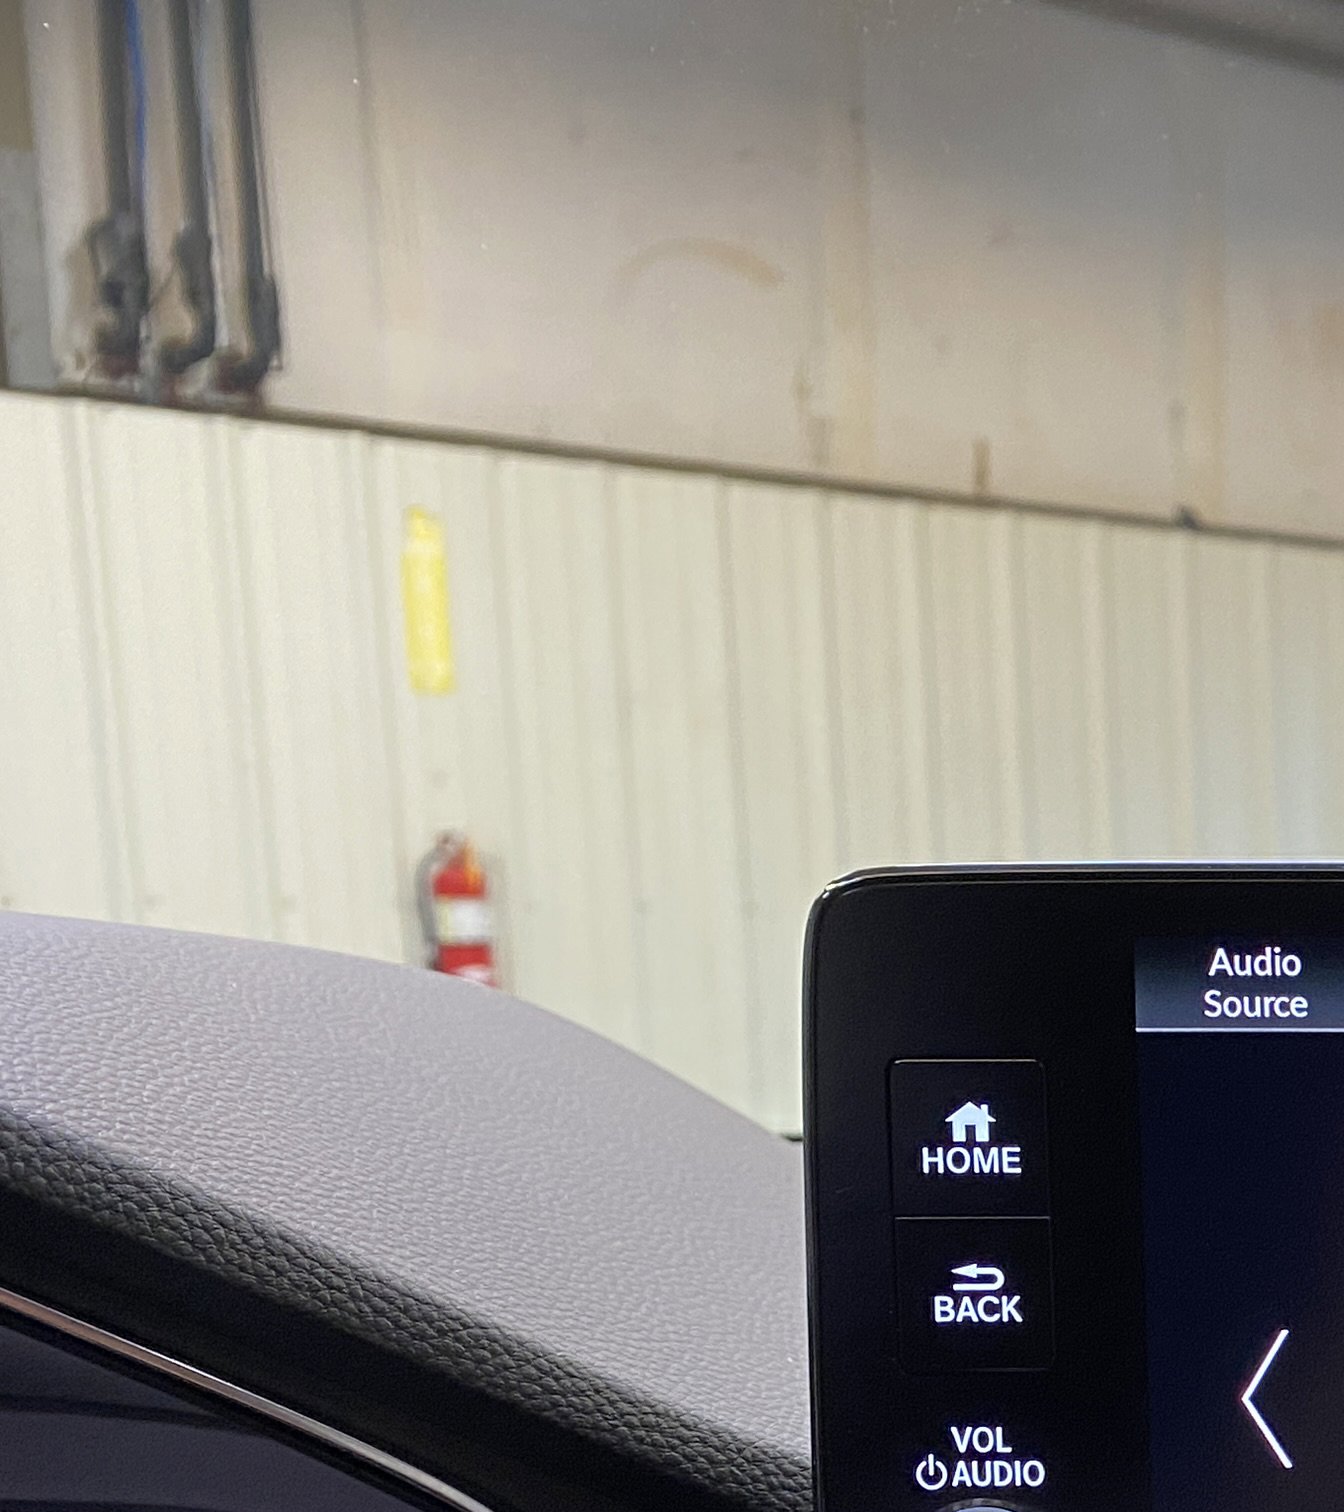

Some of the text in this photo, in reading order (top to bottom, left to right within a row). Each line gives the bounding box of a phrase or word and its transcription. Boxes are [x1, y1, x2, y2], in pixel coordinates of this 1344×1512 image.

[1208, 946, 1302, 977] Audio
[1203, 989, 1309, 1018] Source
[921, 1146, 1022, 1174] HOME
[934, 1297, 1023, 1323] BACK
[950, 1426, 1013, 1454] VOL
[951, 1459, 1046, 1488] AUDIO
